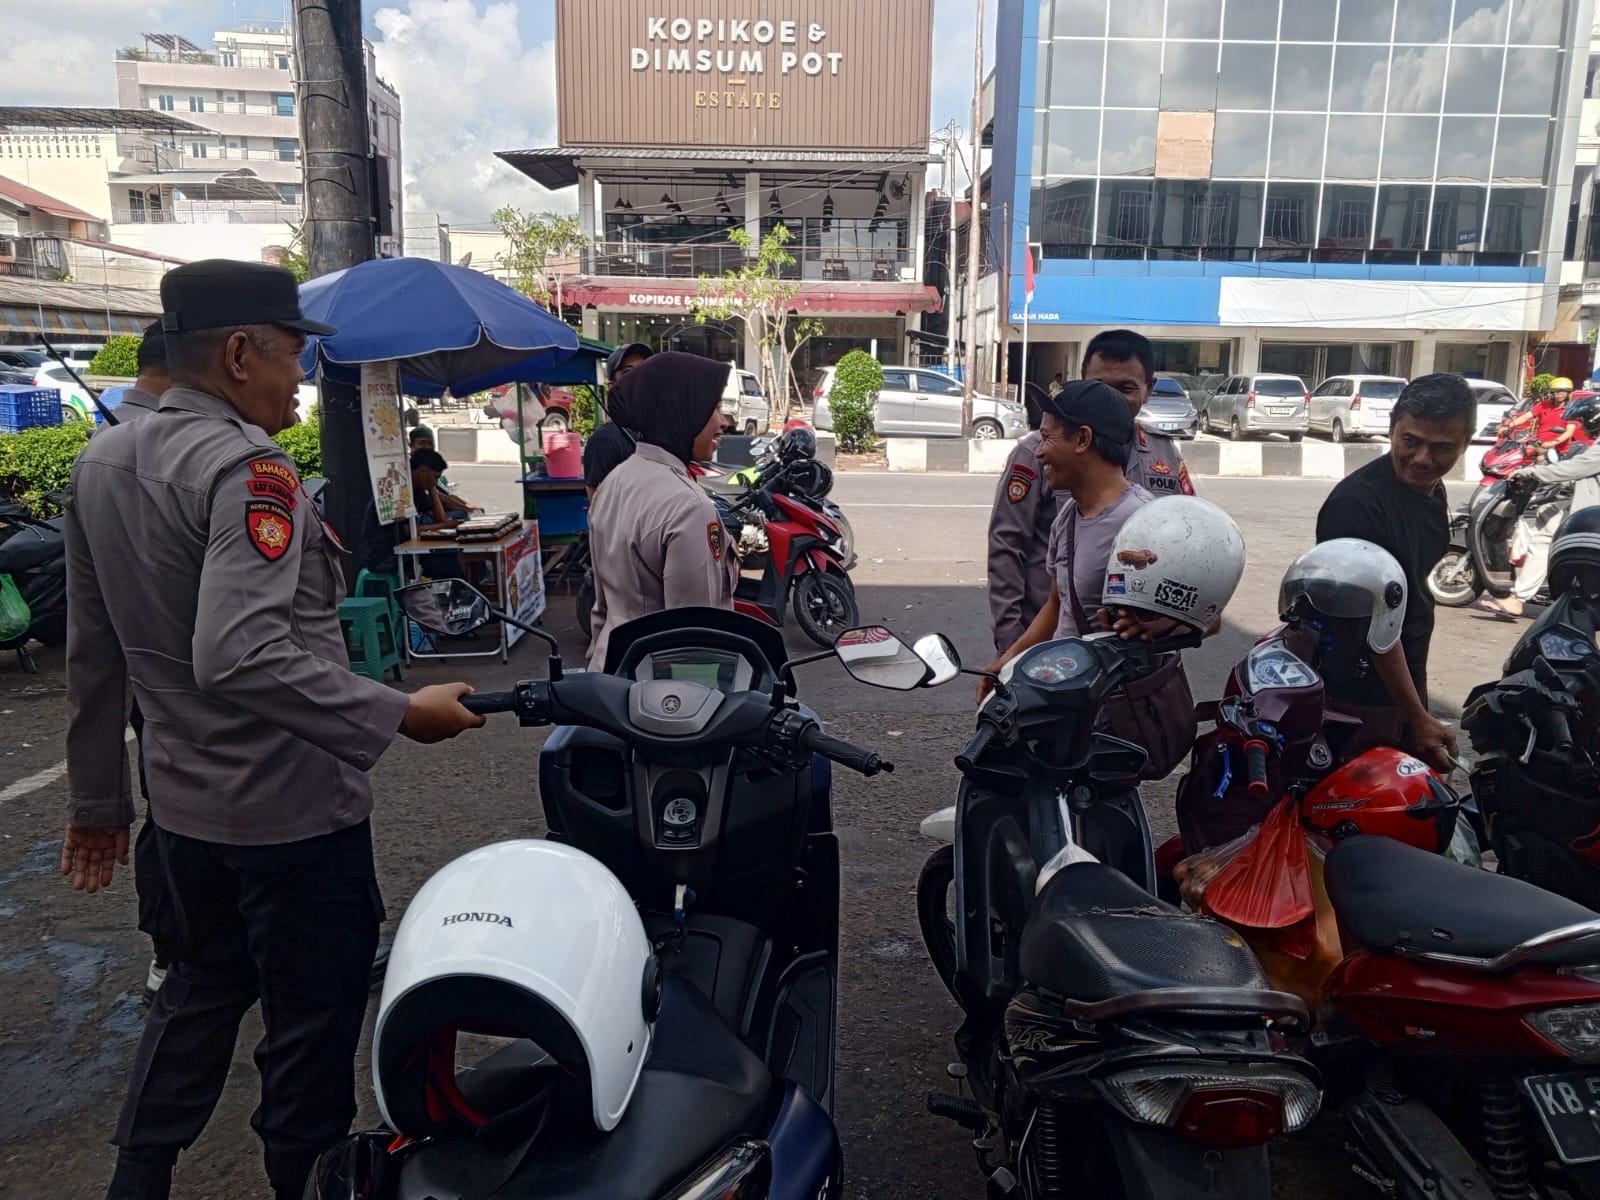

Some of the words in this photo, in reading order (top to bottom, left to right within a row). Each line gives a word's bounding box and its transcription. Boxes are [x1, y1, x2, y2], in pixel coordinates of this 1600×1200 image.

[647, 17, 797, 44] KOPIKOE
[807, 23, 827, 42] &
[631, 47, 764, 74] DIMSUM
[781, 52, 843, 76] POT
[694, 90, 781, 109] ESTATE
[628, 294, 682, 306] KOPIKOE
[254, 463, 296, 488] BAHARKAM
[441, 912, 514, 928] HONDA
[1535, 1082, 1584, 1116] KB
